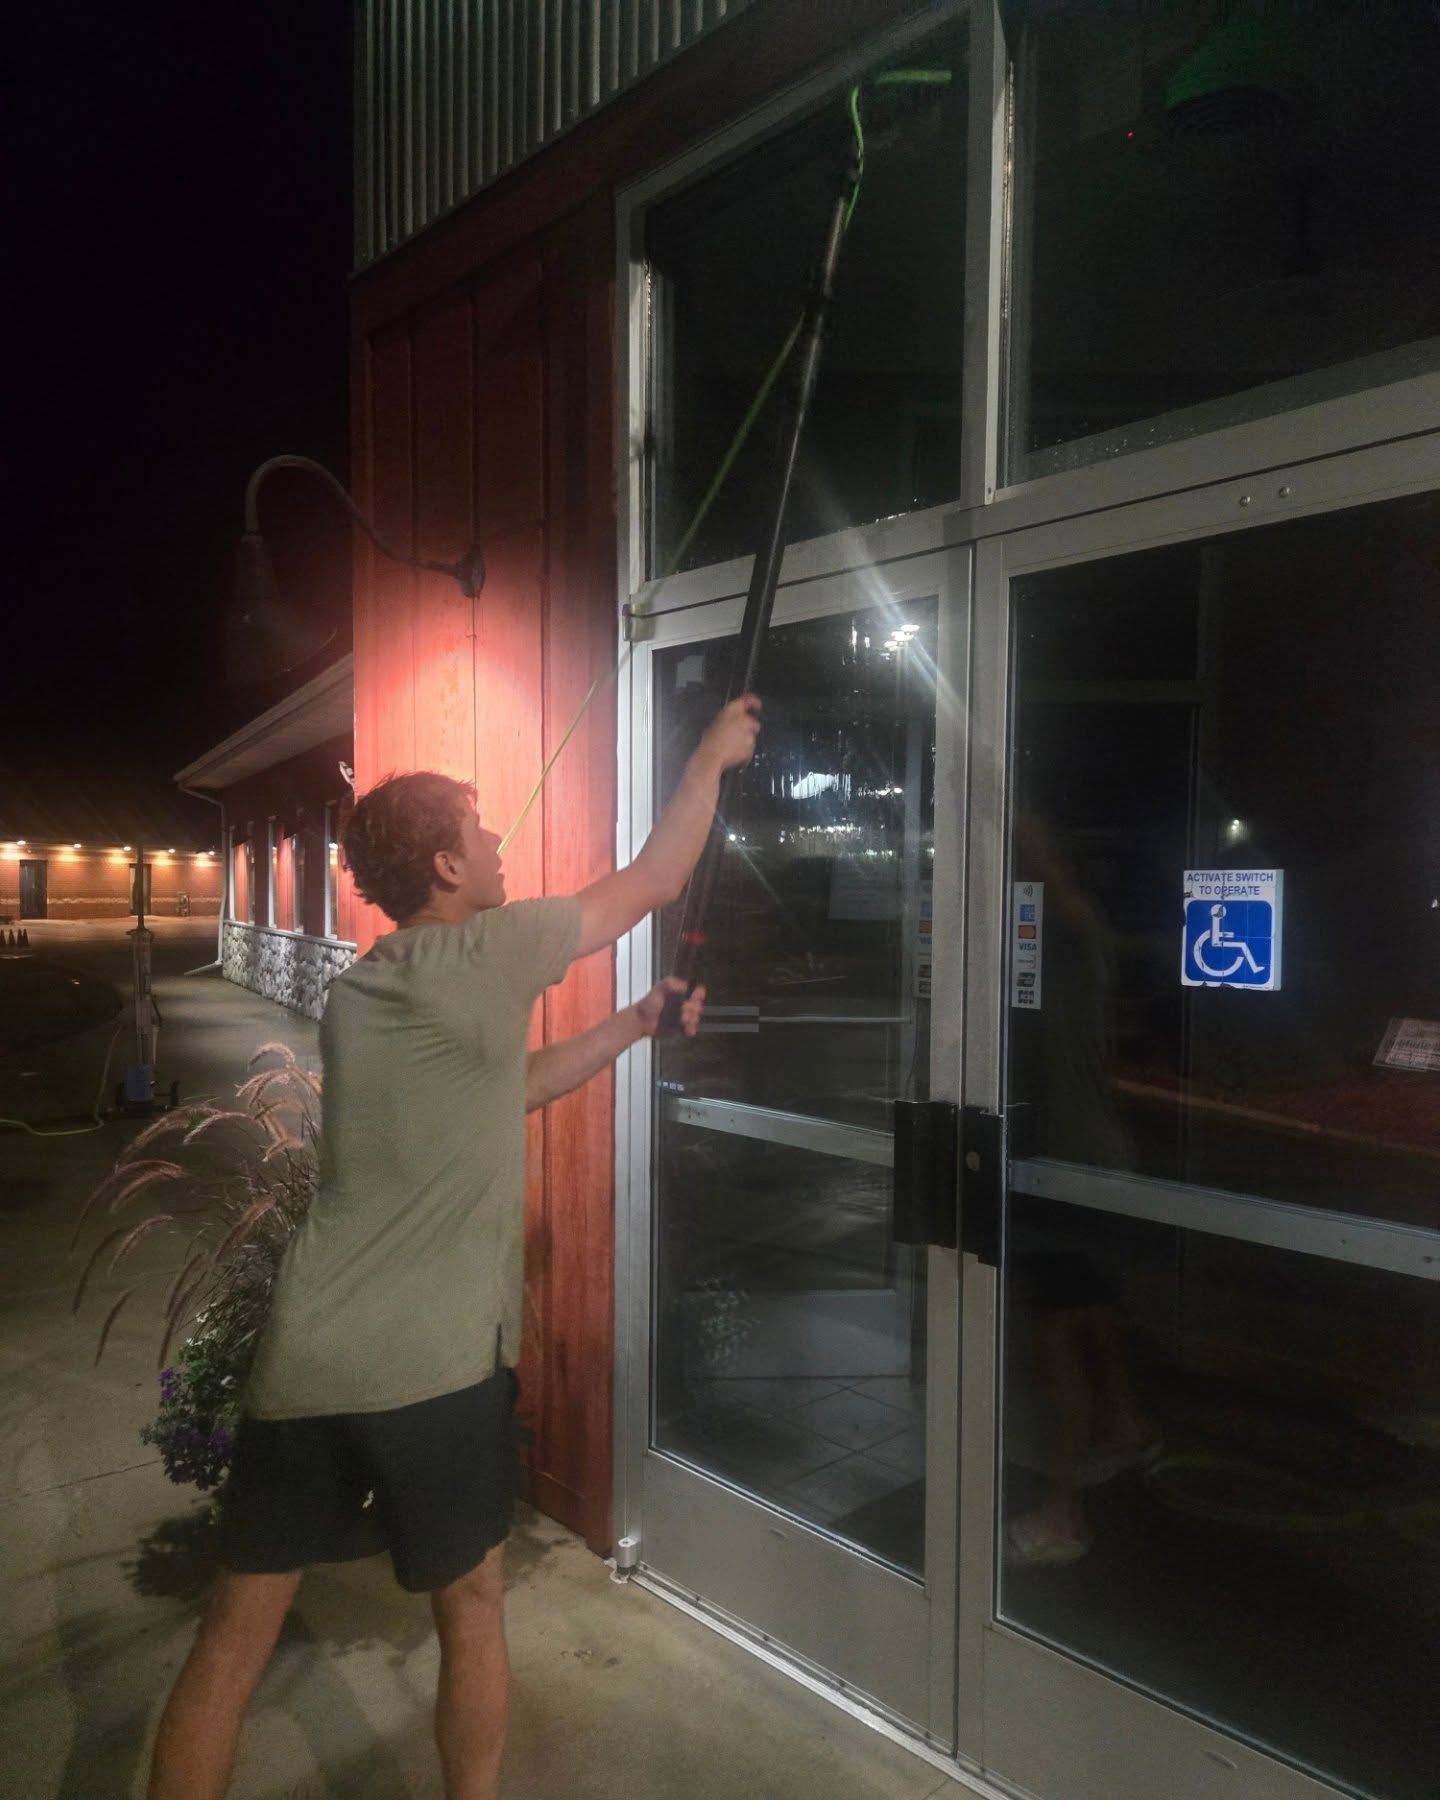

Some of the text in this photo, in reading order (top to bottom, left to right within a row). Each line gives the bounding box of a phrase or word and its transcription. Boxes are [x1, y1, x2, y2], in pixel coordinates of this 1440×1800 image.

[1187, 873, 1274, 882] ACTIVATE SWITCH
[1199, 885, 1260, 896] TO OPERATE
[1019, 943, 1037, 951] VISA
